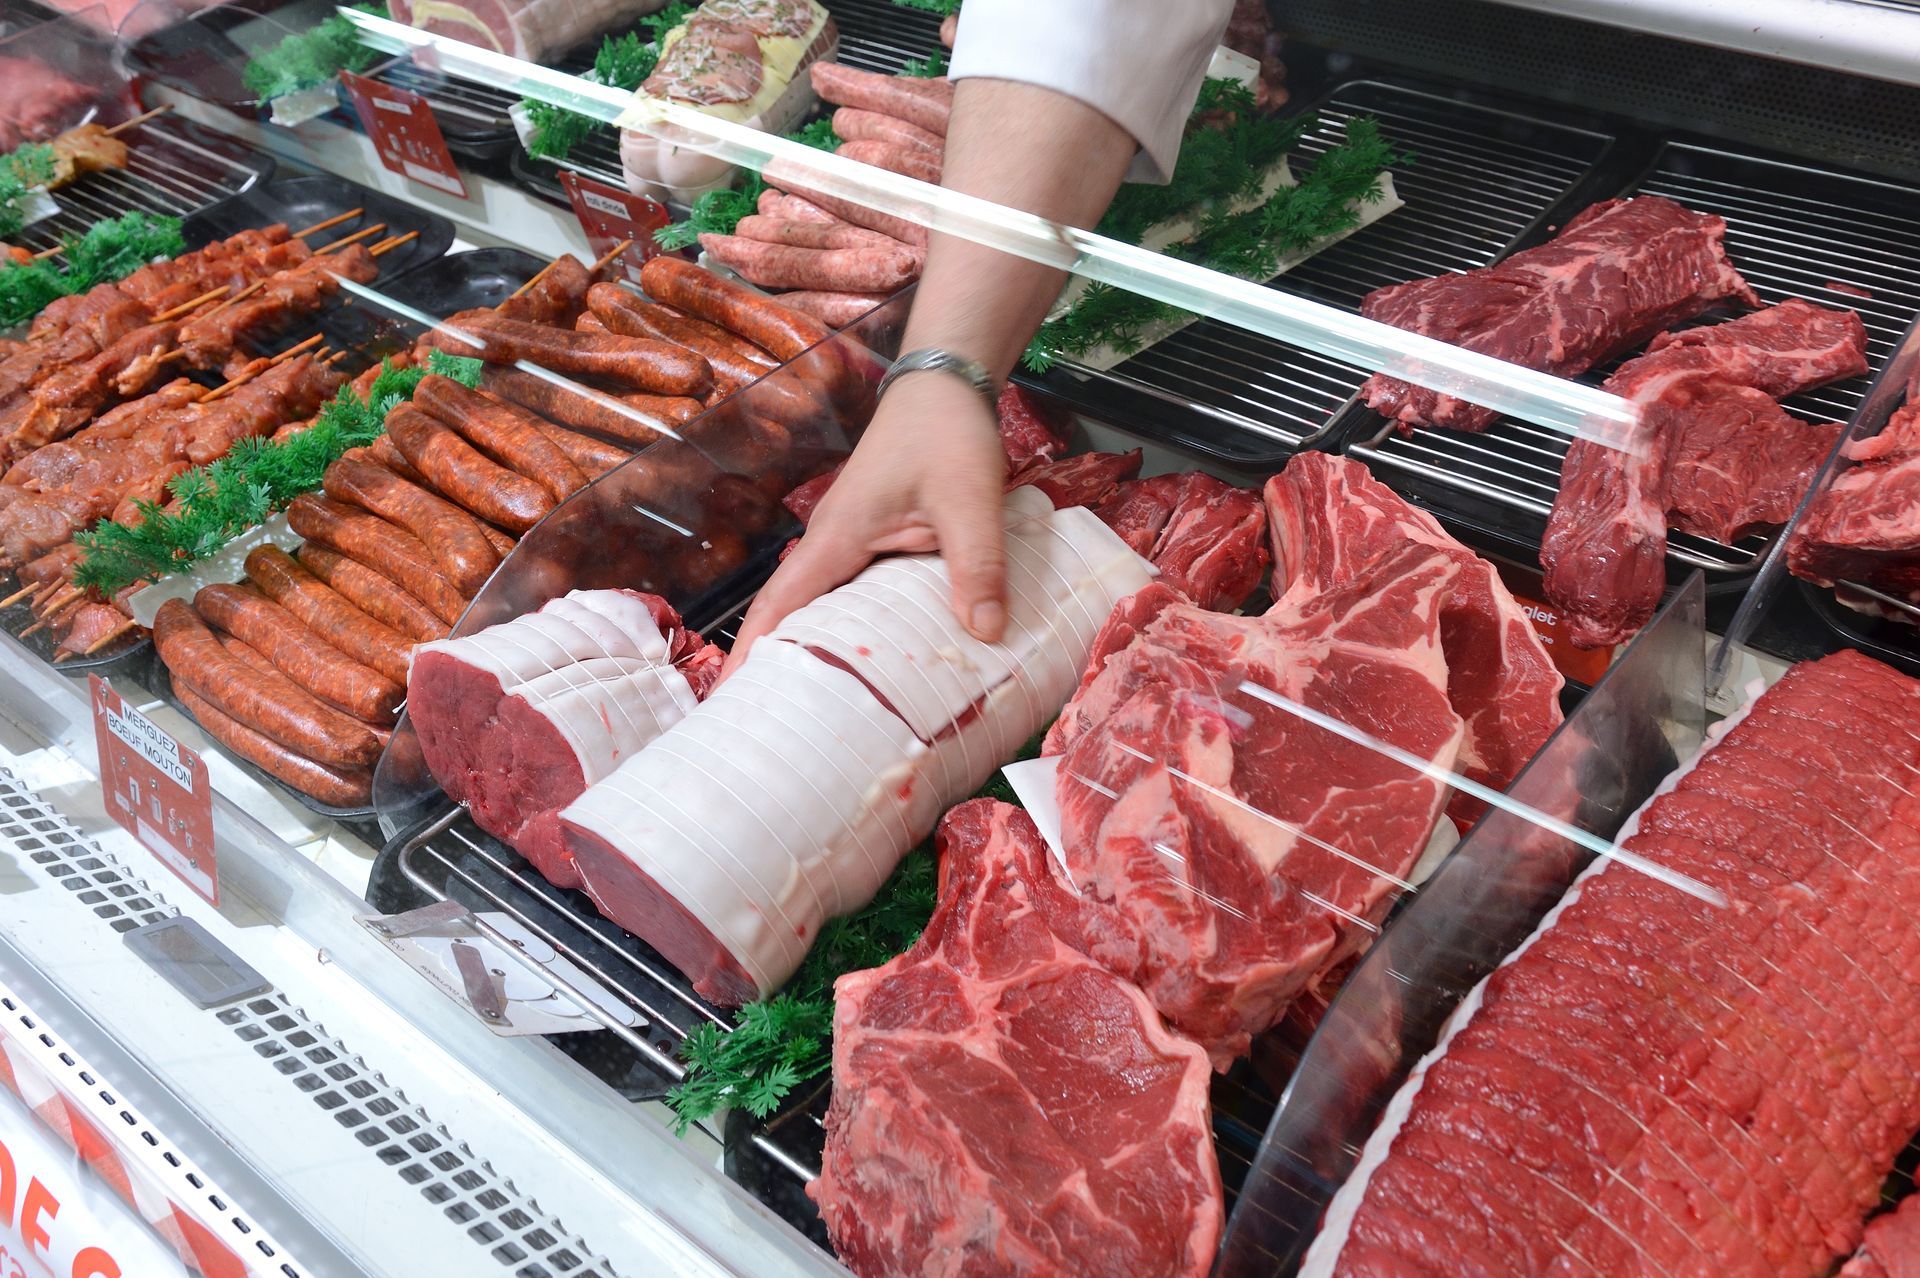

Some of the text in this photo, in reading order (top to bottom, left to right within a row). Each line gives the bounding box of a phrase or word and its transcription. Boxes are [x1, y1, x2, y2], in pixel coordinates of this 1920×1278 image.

[1521, 606, 1557, 625] glet
[108, 713, 192, 787] BOEUF MOUTON
[124, 706, 177, 757] MERGUEZ
